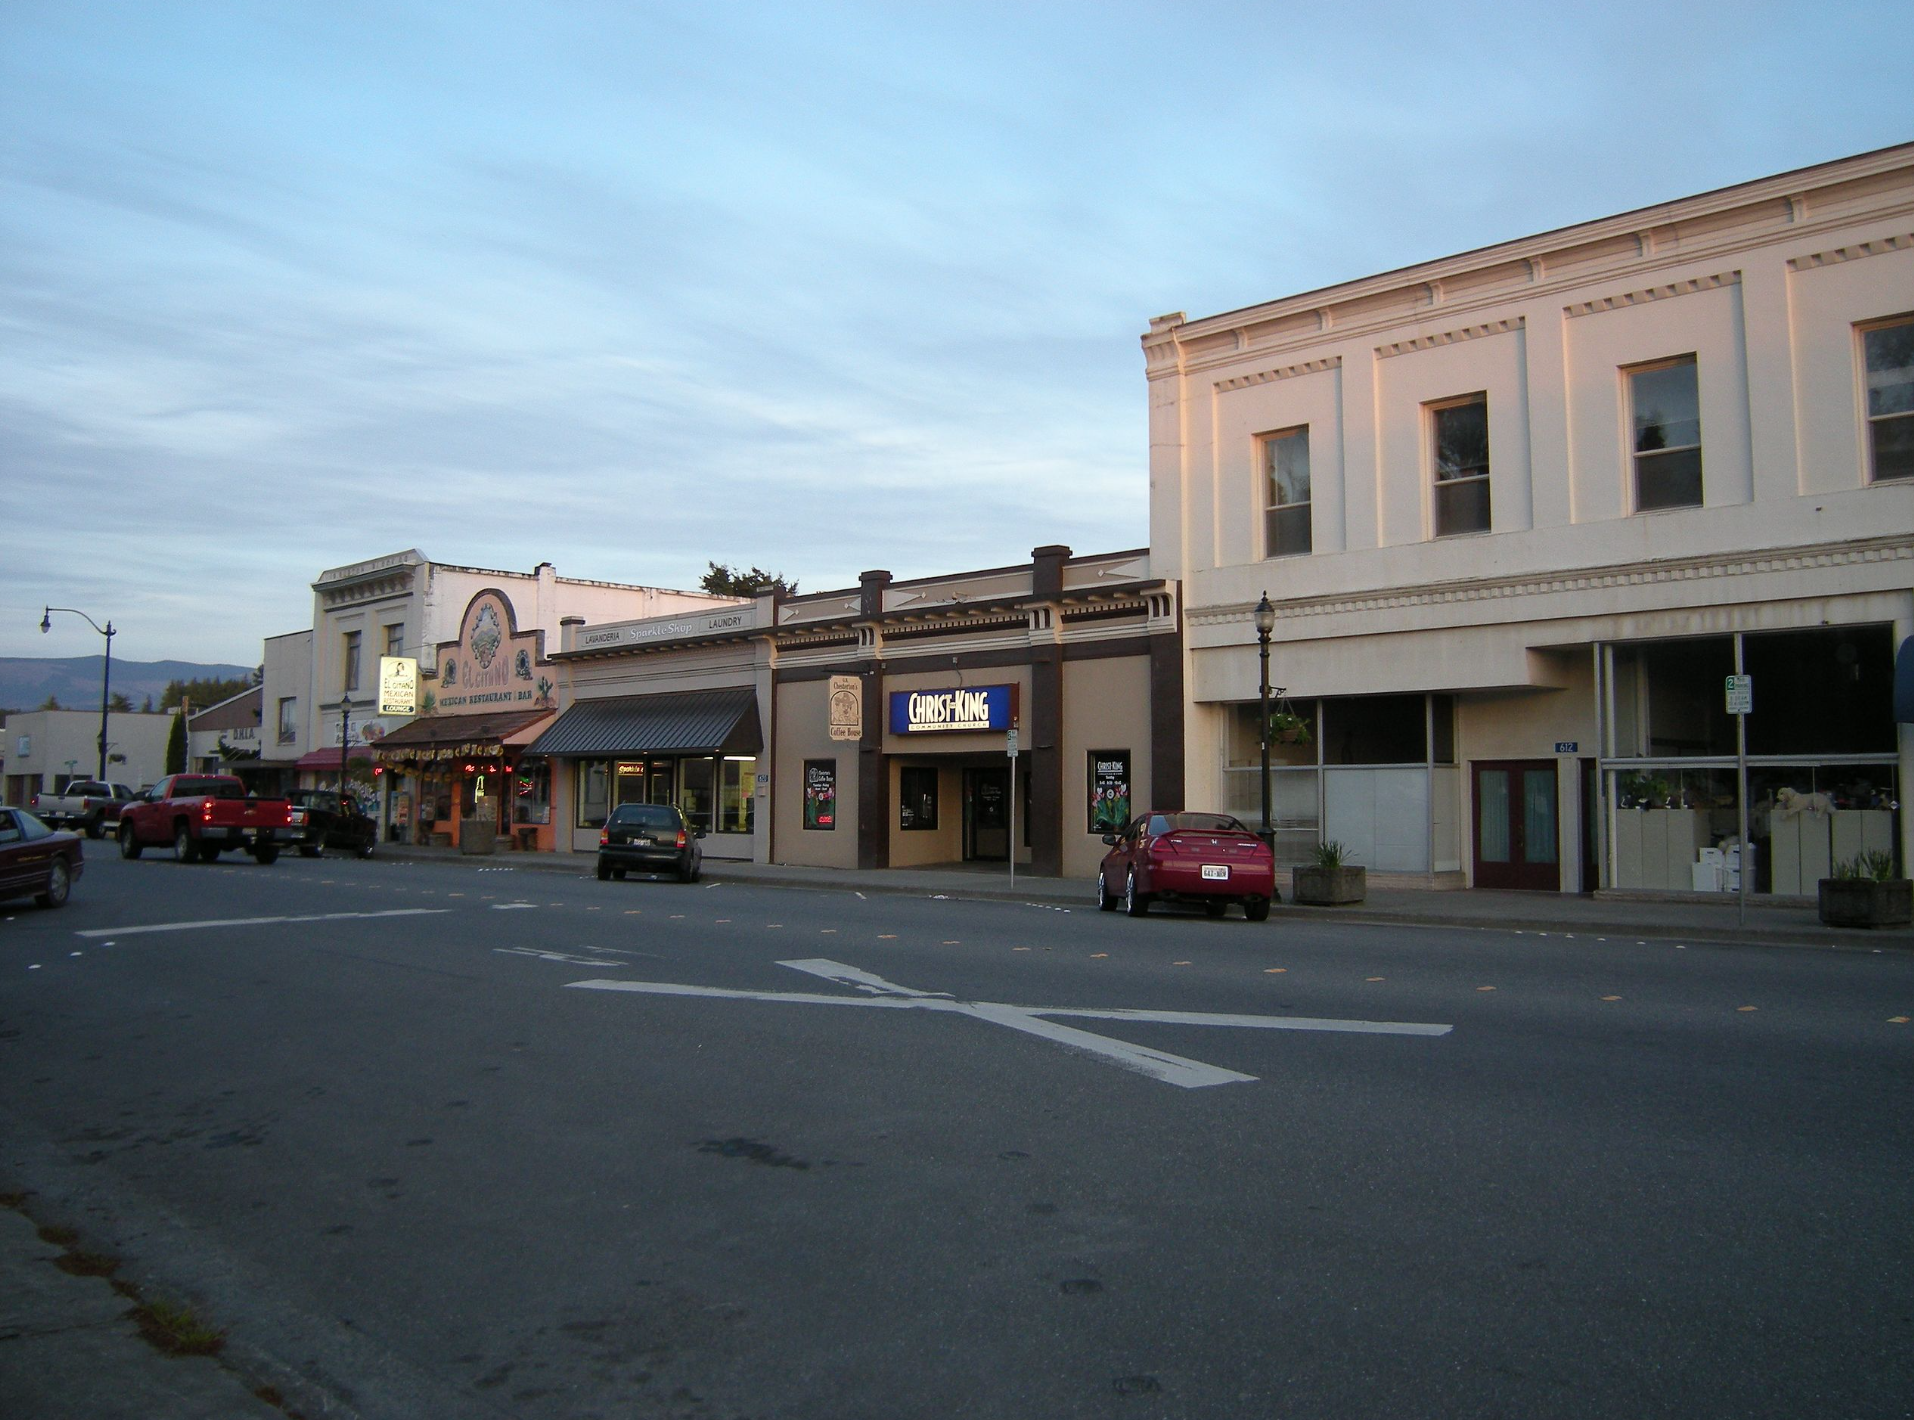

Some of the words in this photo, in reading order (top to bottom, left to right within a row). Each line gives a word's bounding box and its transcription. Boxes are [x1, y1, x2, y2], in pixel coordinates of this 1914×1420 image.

[585, 632, 620, 644] LAVANDERIA
[630, 626, 667, 641] Sparkle
[668, 622, 692, 635] Shop
[708, 616, 742, 629] LAUNDRY
[462, 660, 475, 689] EL
[384, 677, 391, 689] EL
[833, 681, 858, 690] Chesterton's
[1727, 678, 1735, 689] 2
[383, 690, 414, 698] MEXICAN
[440, 695, 467, 707] MEXICAN
[469, 691, 513, 704] RESTAURANT
[518, 689, 533, 701] BAR
[908, 692, 953, 723] CHRIST
[955, 690, 989, 722] KING
[830, 726, 846, 737] Coffee
[847, 727, 862, 737] House
[1559, 743, 1574, 752] 612
